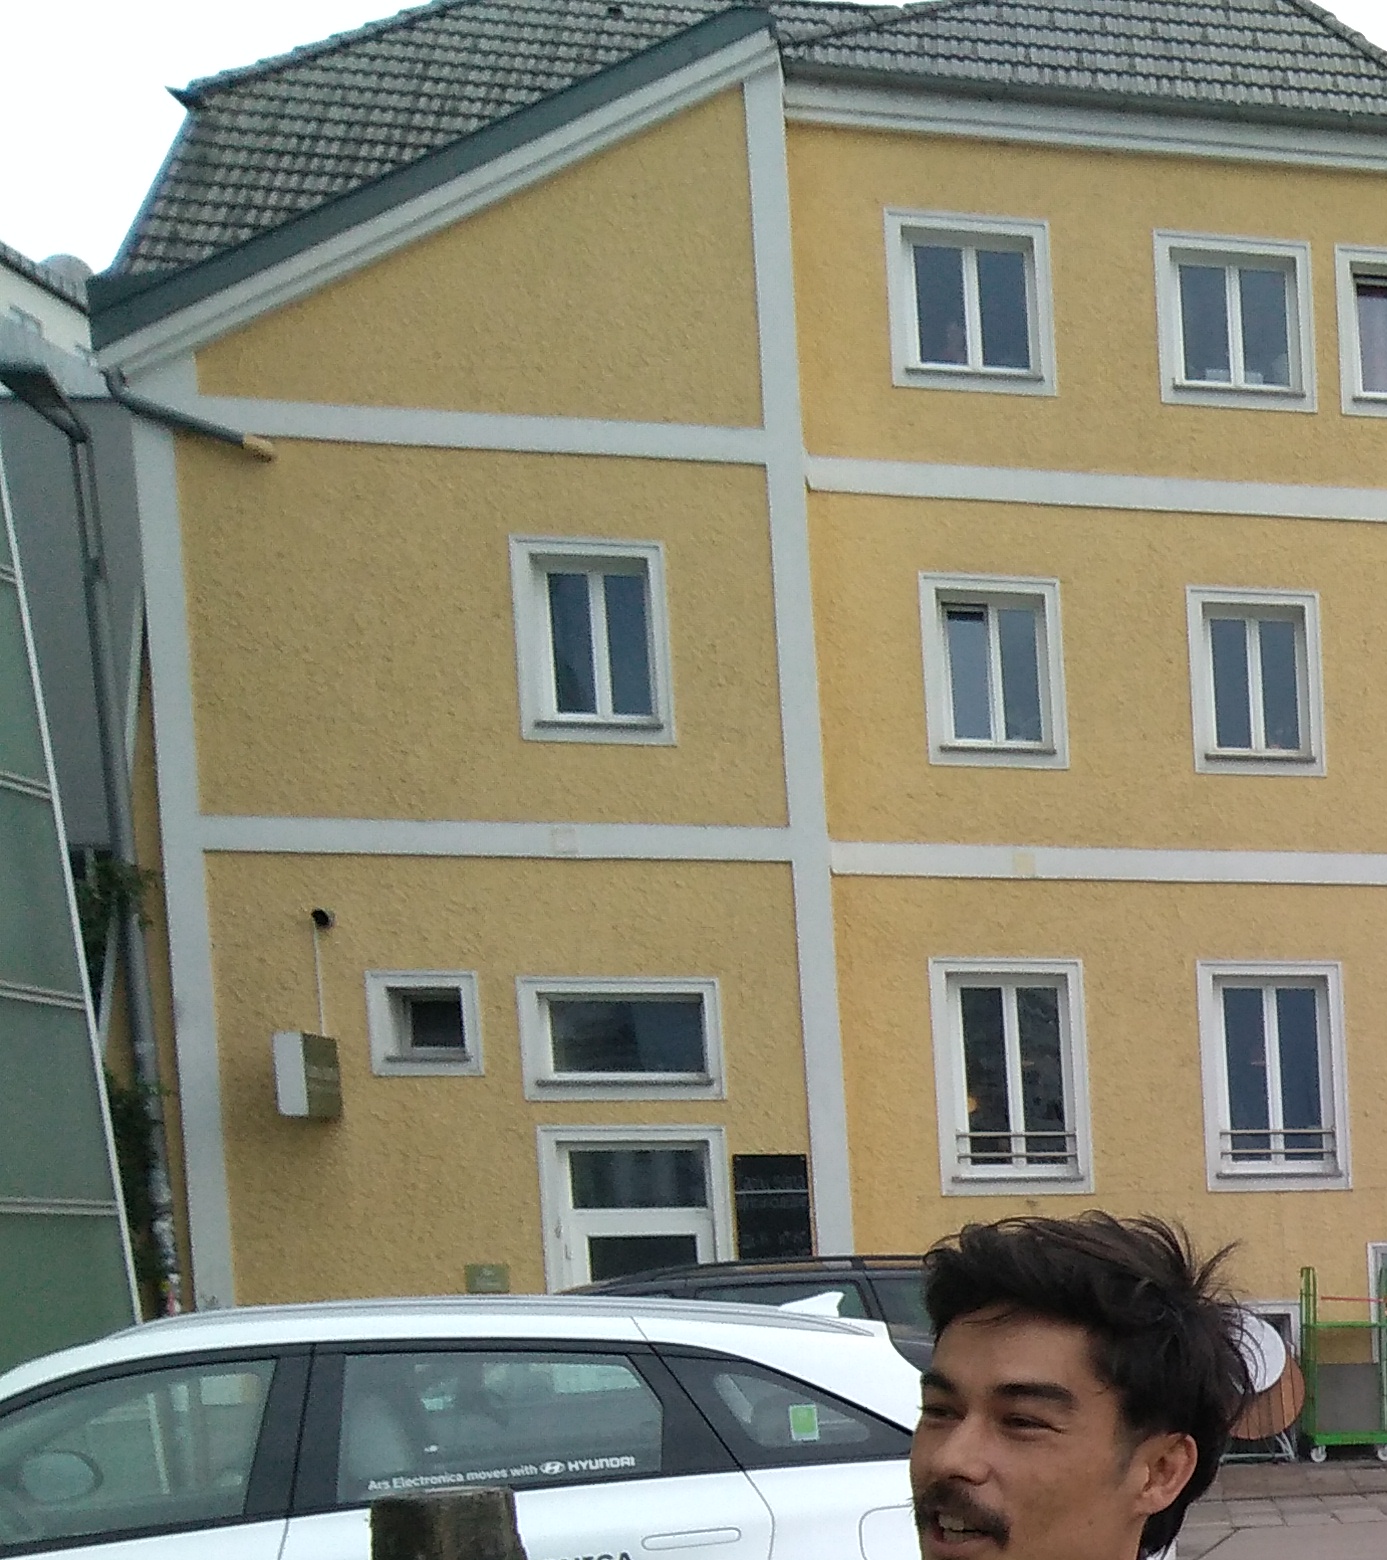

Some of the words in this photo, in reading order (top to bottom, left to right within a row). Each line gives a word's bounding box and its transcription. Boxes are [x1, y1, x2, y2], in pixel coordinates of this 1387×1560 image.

[368, 1480, 390, 1491] Ars
[393, 1473, 464, 1489] Electronica
[467, 1468, 508, 1481] moves
[510, 1465, 538, 1477] with
[568, 1456, 636, 1472] HYUNDAI
